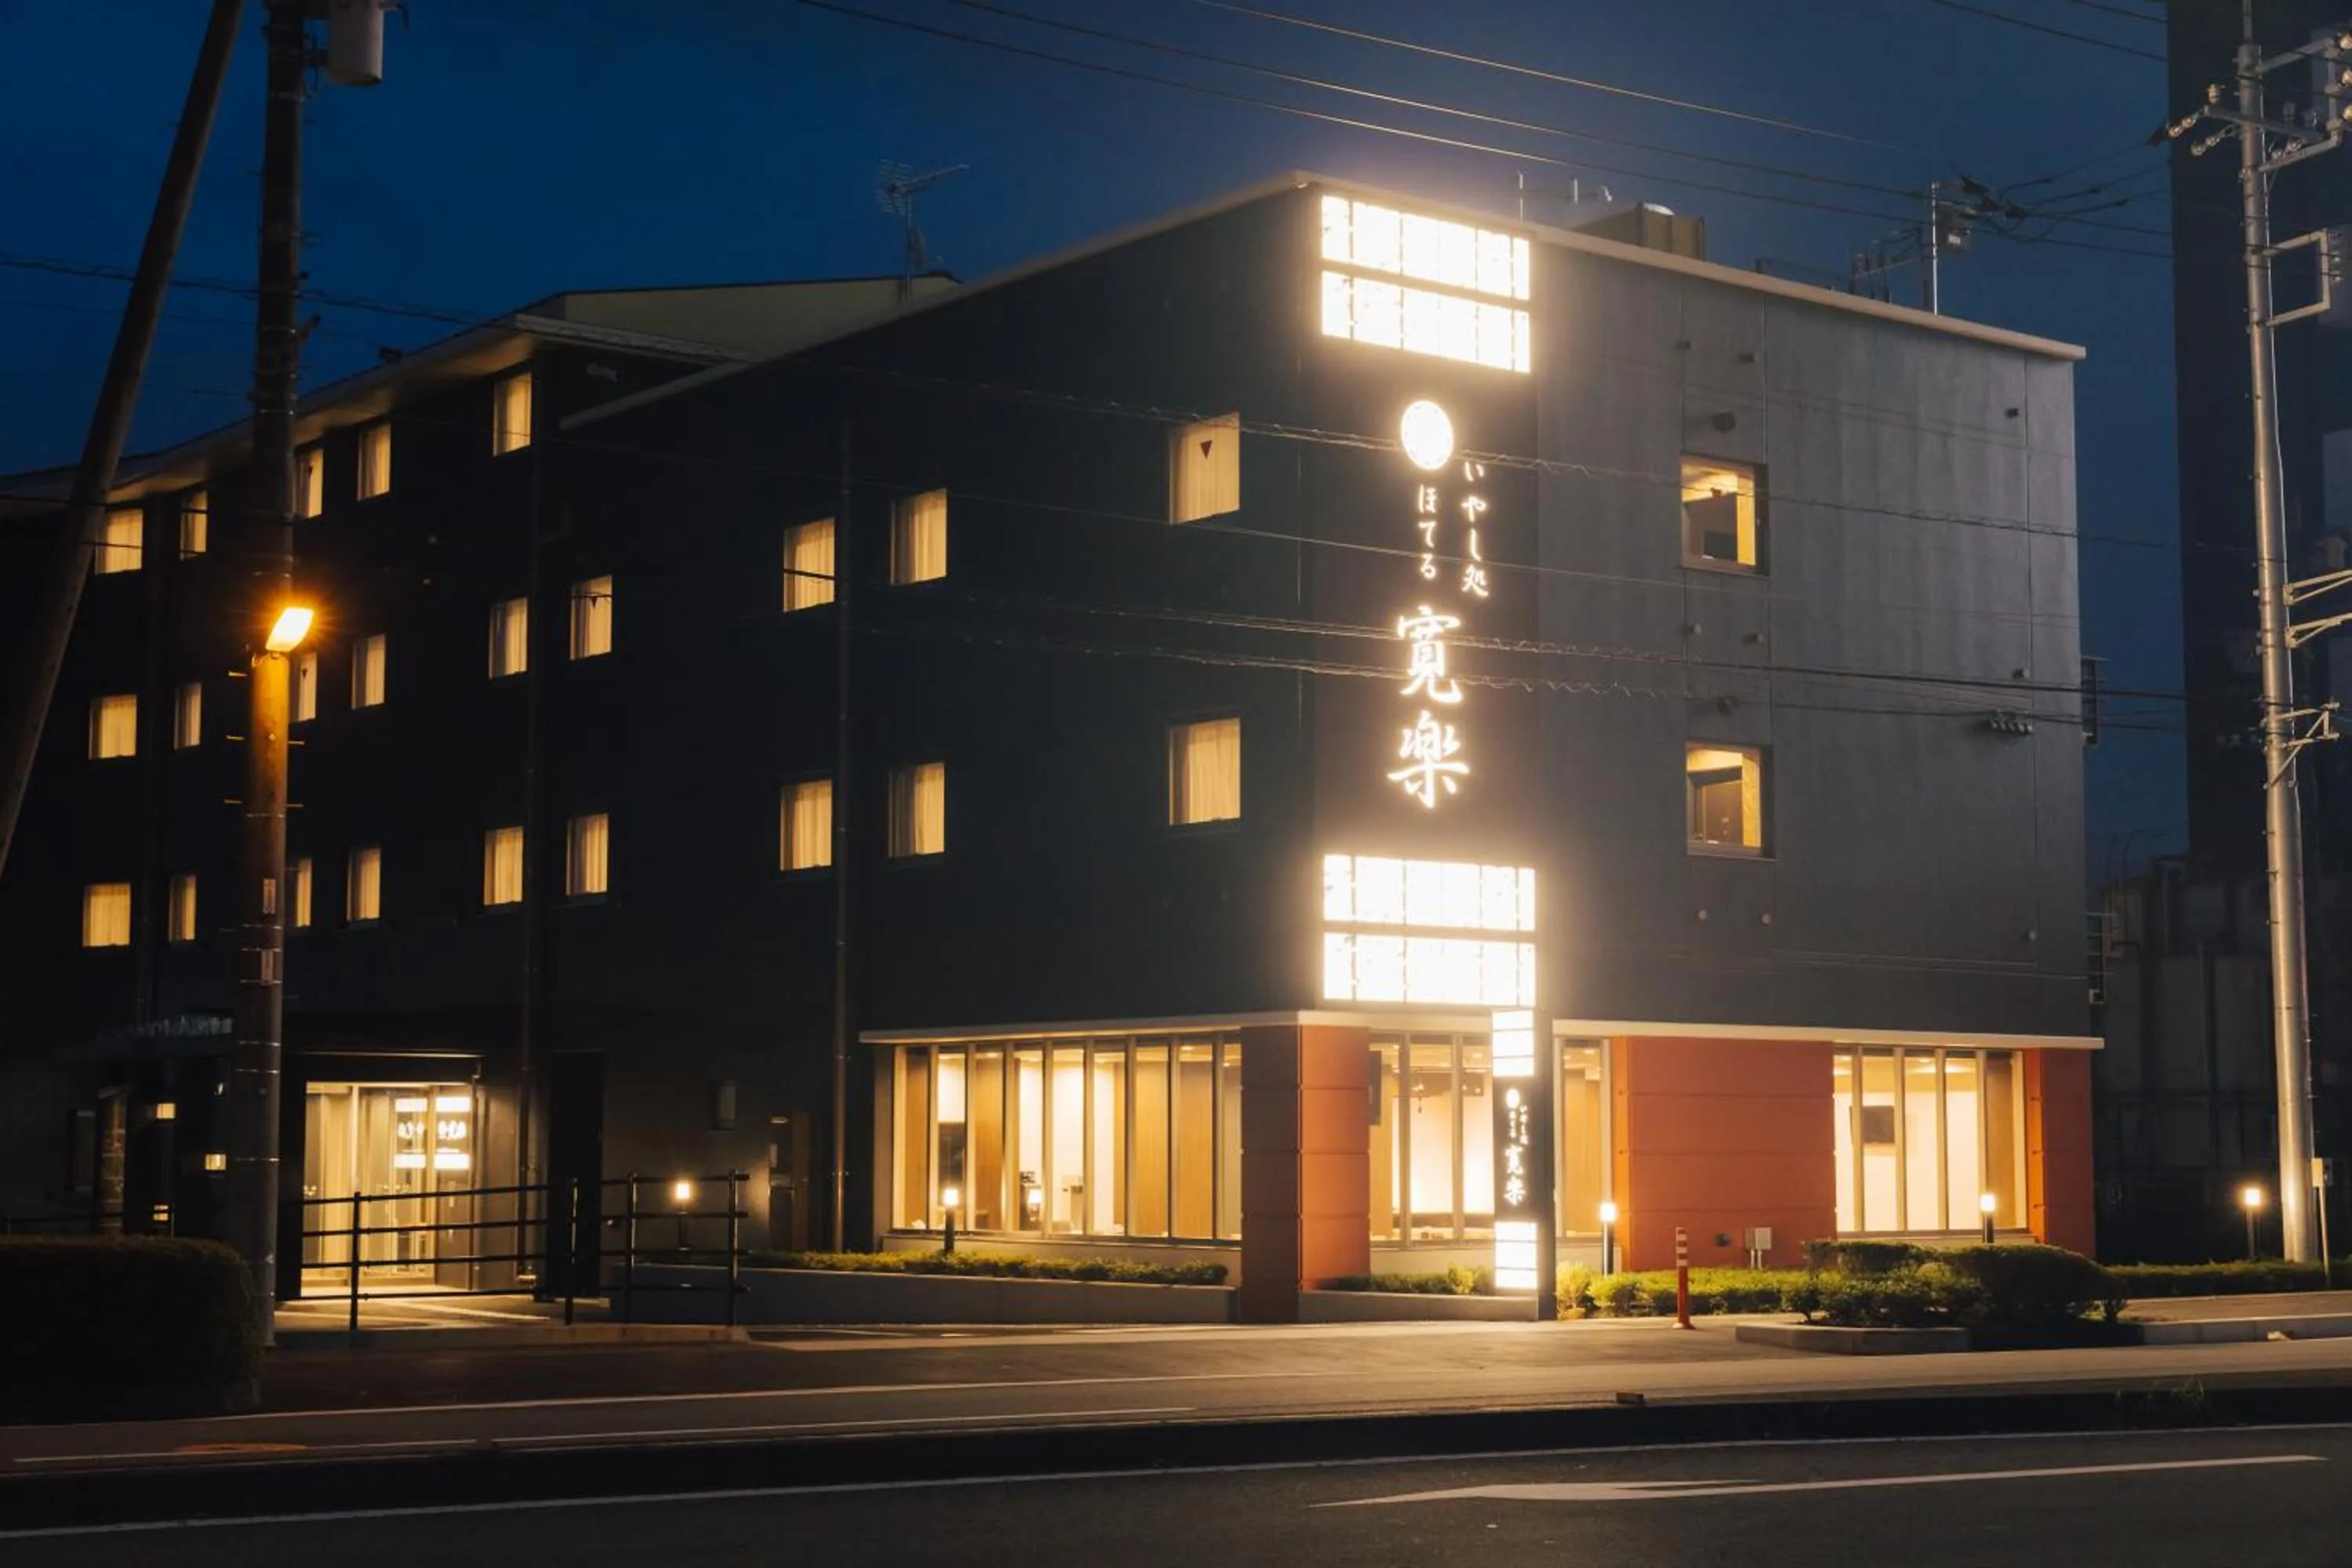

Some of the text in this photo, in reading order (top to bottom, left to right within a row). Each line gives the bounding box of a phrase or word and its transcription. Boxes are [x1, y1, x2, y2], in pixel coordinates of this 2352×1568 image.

[1417, 484, 1437, 580] ほてる
[1461, 461, 1489, 597] いやし処
[1386, 604, 1471, 810] 寛楽
